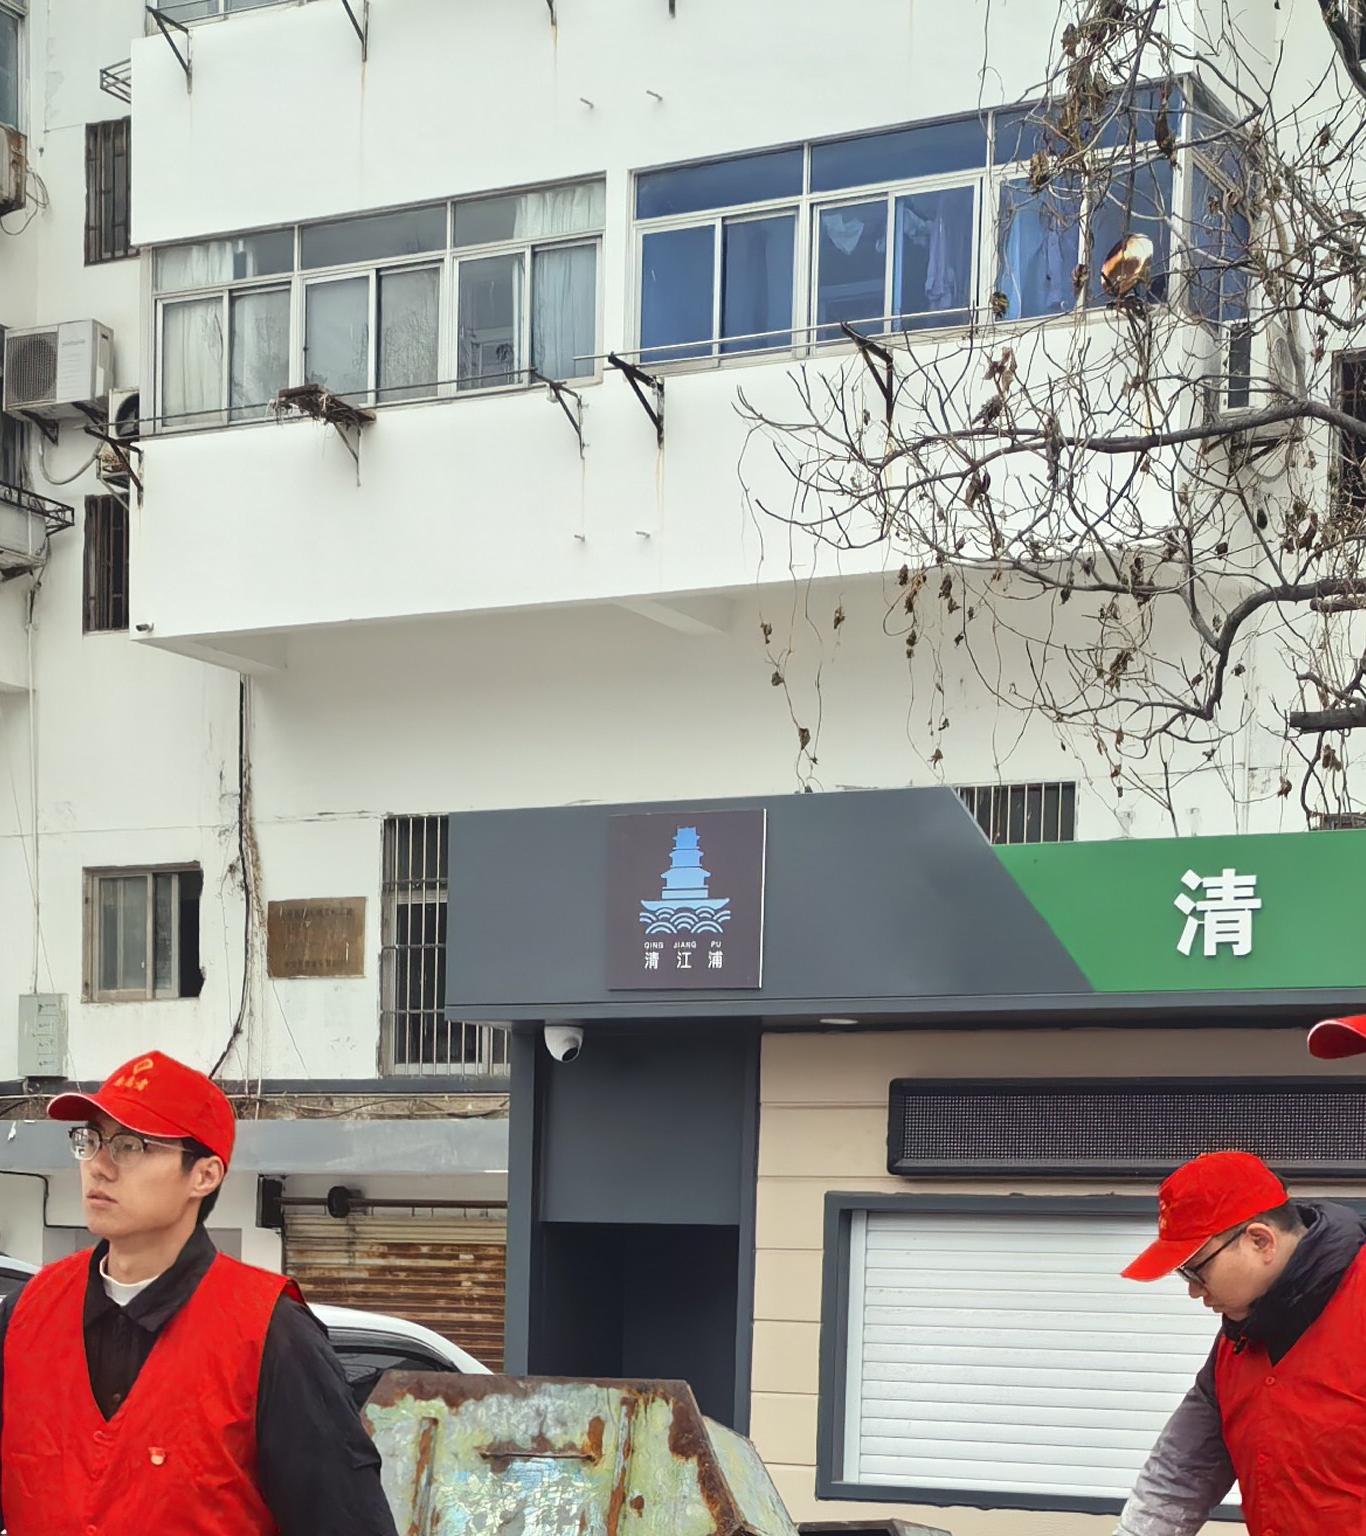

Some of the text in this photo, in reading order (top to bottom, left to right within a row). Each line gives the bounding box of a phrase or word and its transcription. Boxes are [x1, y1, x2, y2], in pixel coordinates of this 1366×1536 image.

[644, 940, 722, 950] QING JIANG PU
[644, 951, 724, 970] 清江浦
